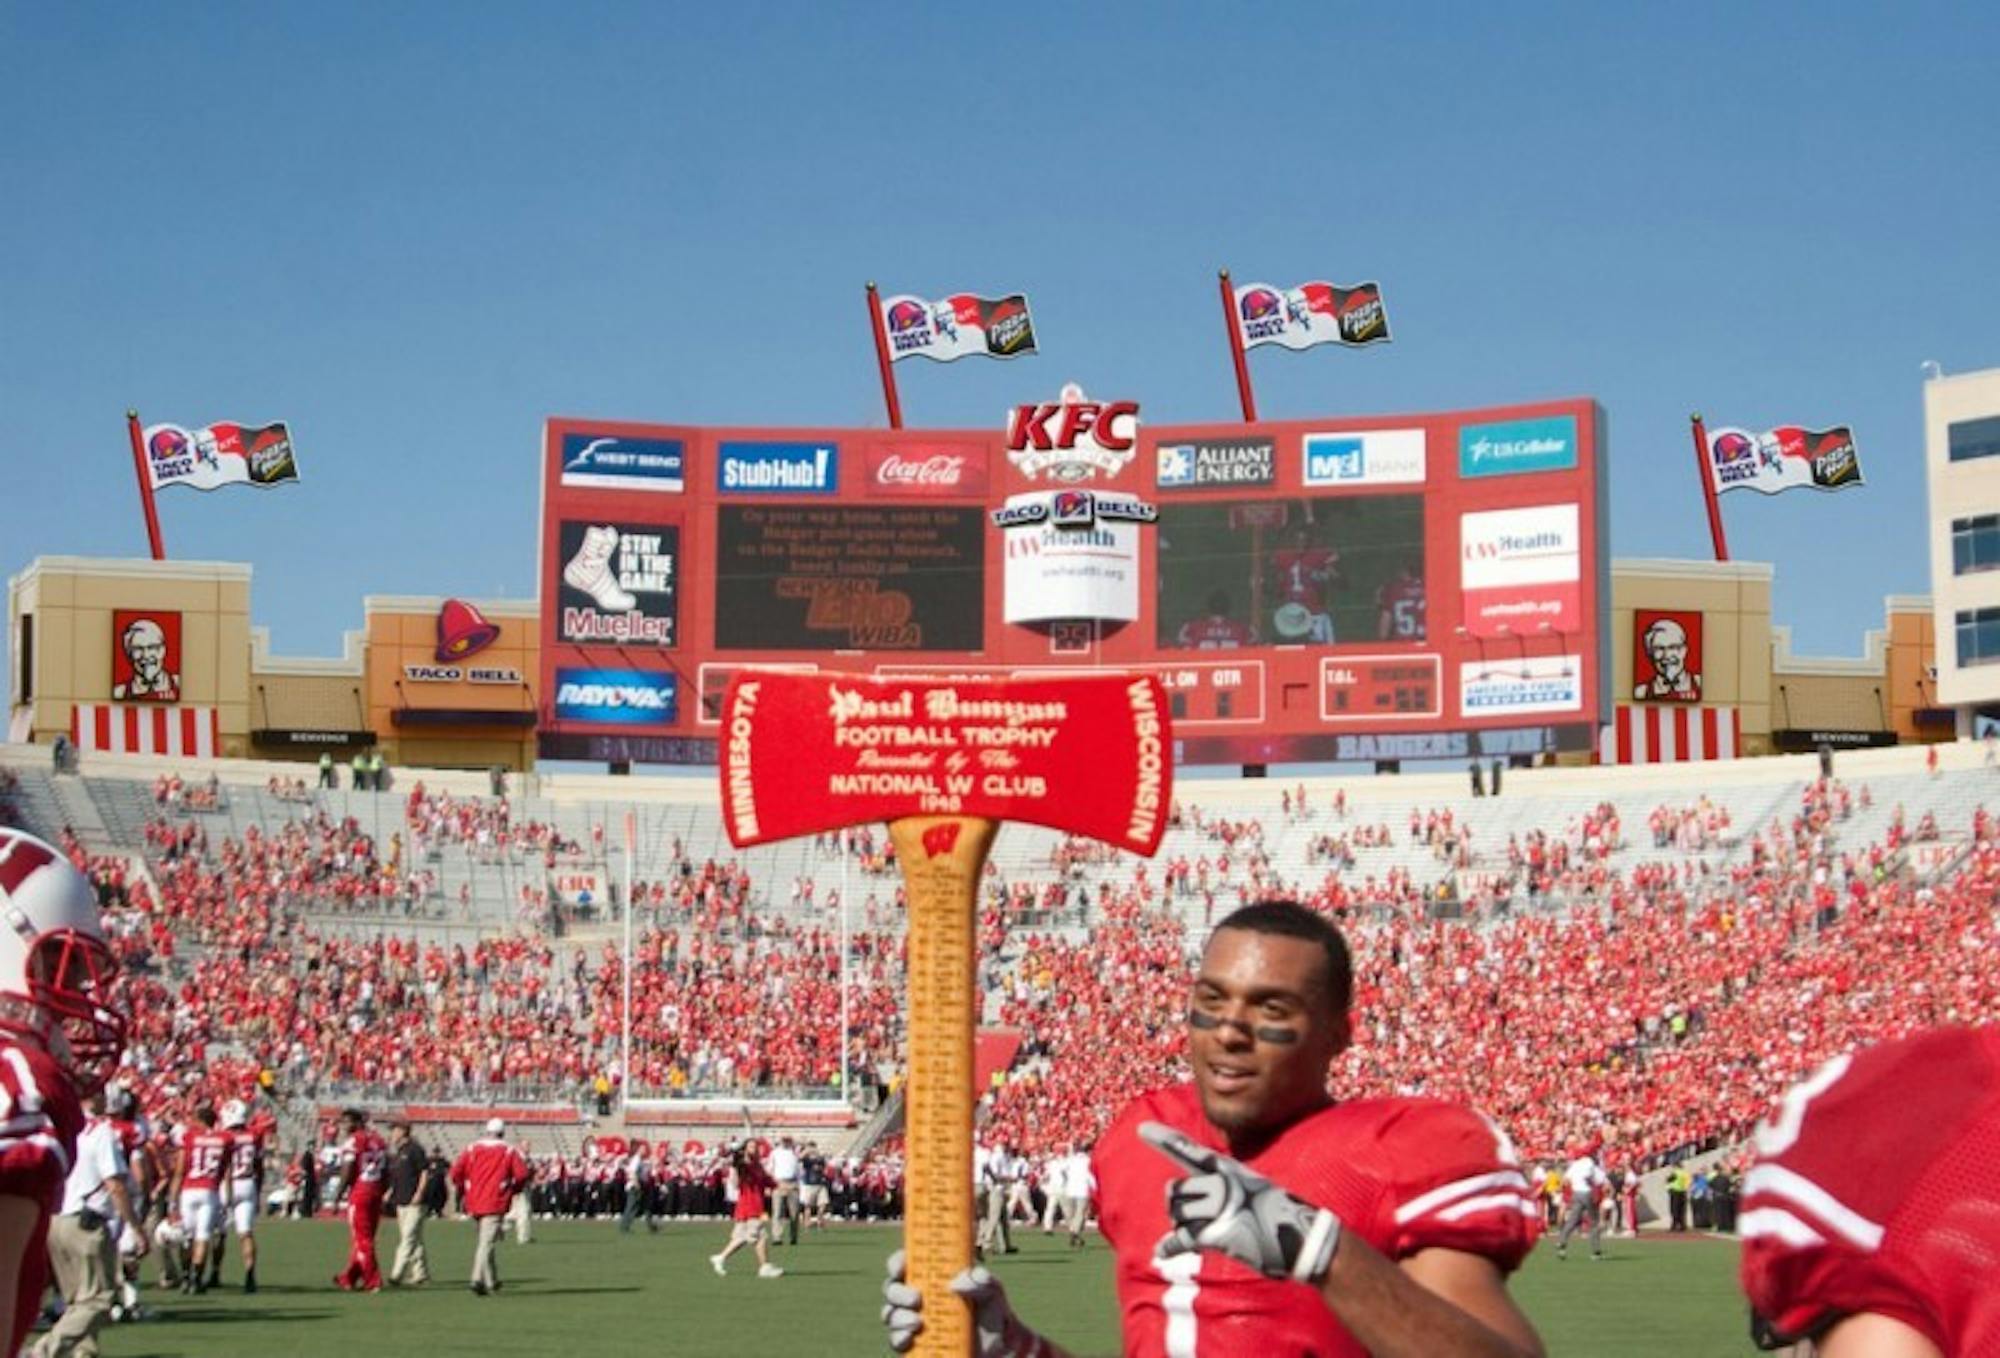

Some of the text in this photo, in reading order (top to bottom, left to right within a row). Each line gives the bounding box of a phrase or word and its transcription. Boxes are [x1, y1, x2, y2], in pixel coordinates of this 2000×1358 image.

[1008, 402, 1140, 450] KFC
[595, 451, 681, 469] WEST BEND
[1197, 445, 1272, 464] ALLIANT
[724, 449, 828, 487] StubHub!
[877, 455, 966, 484] Coca-Cola
[995, 501, 1152, 522] TACO BELL
[621, 534, 662, 553] STAY
[1042, 528, 1116, 547] Health
[1500, 532, 1562, 551] Health
[620, 554, 672, 573] IN THE
[564, 607, 673, 639] Mueller
[408, 667, 521, 682] TACO BELL
[1212, 668, 1241, 687] QTR
[557, 682, 674, 709] RAYOVAC
[829, 681, 1067, 726] Paul Bunyan
[291, 732, 349, 744] BIENVENUE
[835, 725, 1058, 748] FOOTBALL TROPHY
[1336, 732, 1468, 760] BADGERS
[1811, 732, 1870, 743] BIENVENUE
[728, 681, 762, 841] MINNESOTA
[1126, 677, 1162, 844] WISCONSIN
[830, 773, 1047, 798] NATIONAL W CLUB
